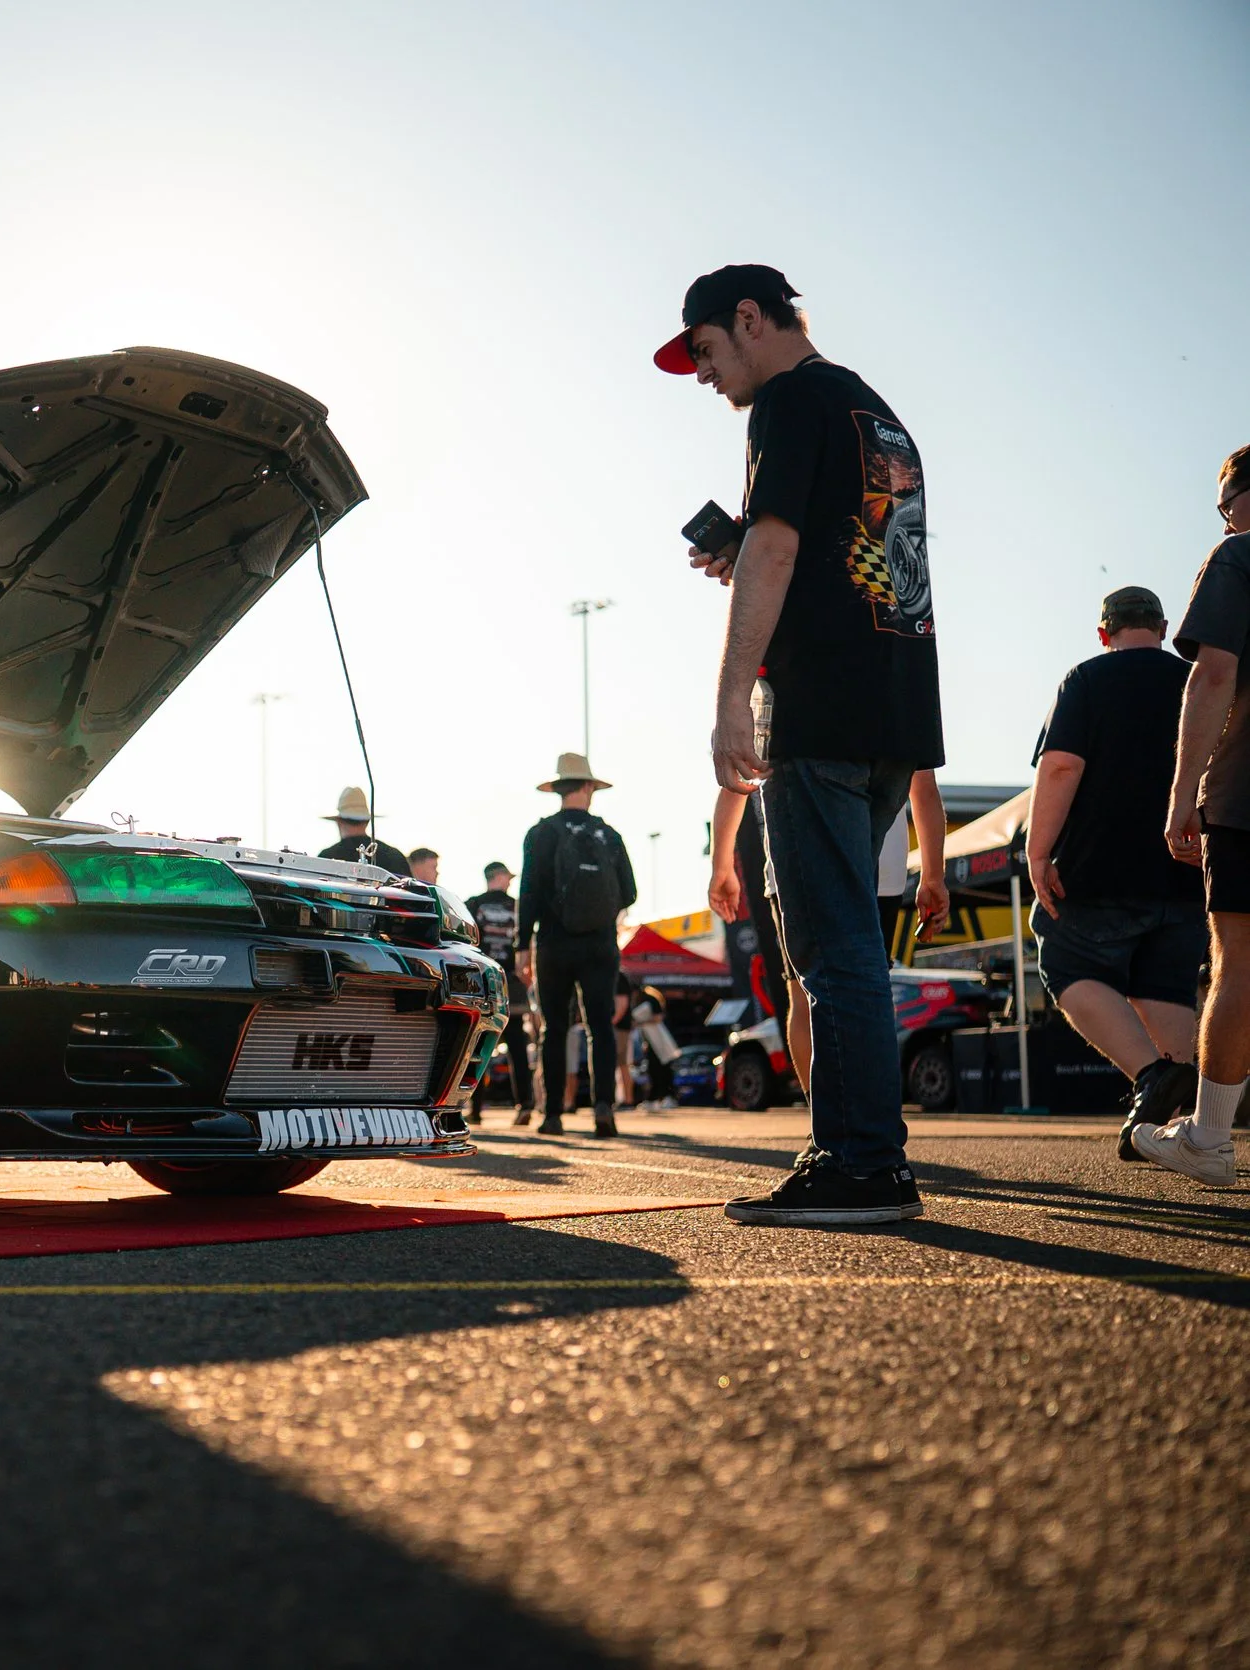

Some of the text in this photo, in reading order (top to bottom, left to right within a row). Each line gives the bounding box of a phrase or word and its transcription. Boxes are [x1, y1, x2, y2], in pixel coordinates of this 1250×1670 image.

[874, 421, 910, 449] Garrett
[292, 1034, 374, 1071] HKS
[258, 1108, 435, 1152] MOTIVEVIDEO
